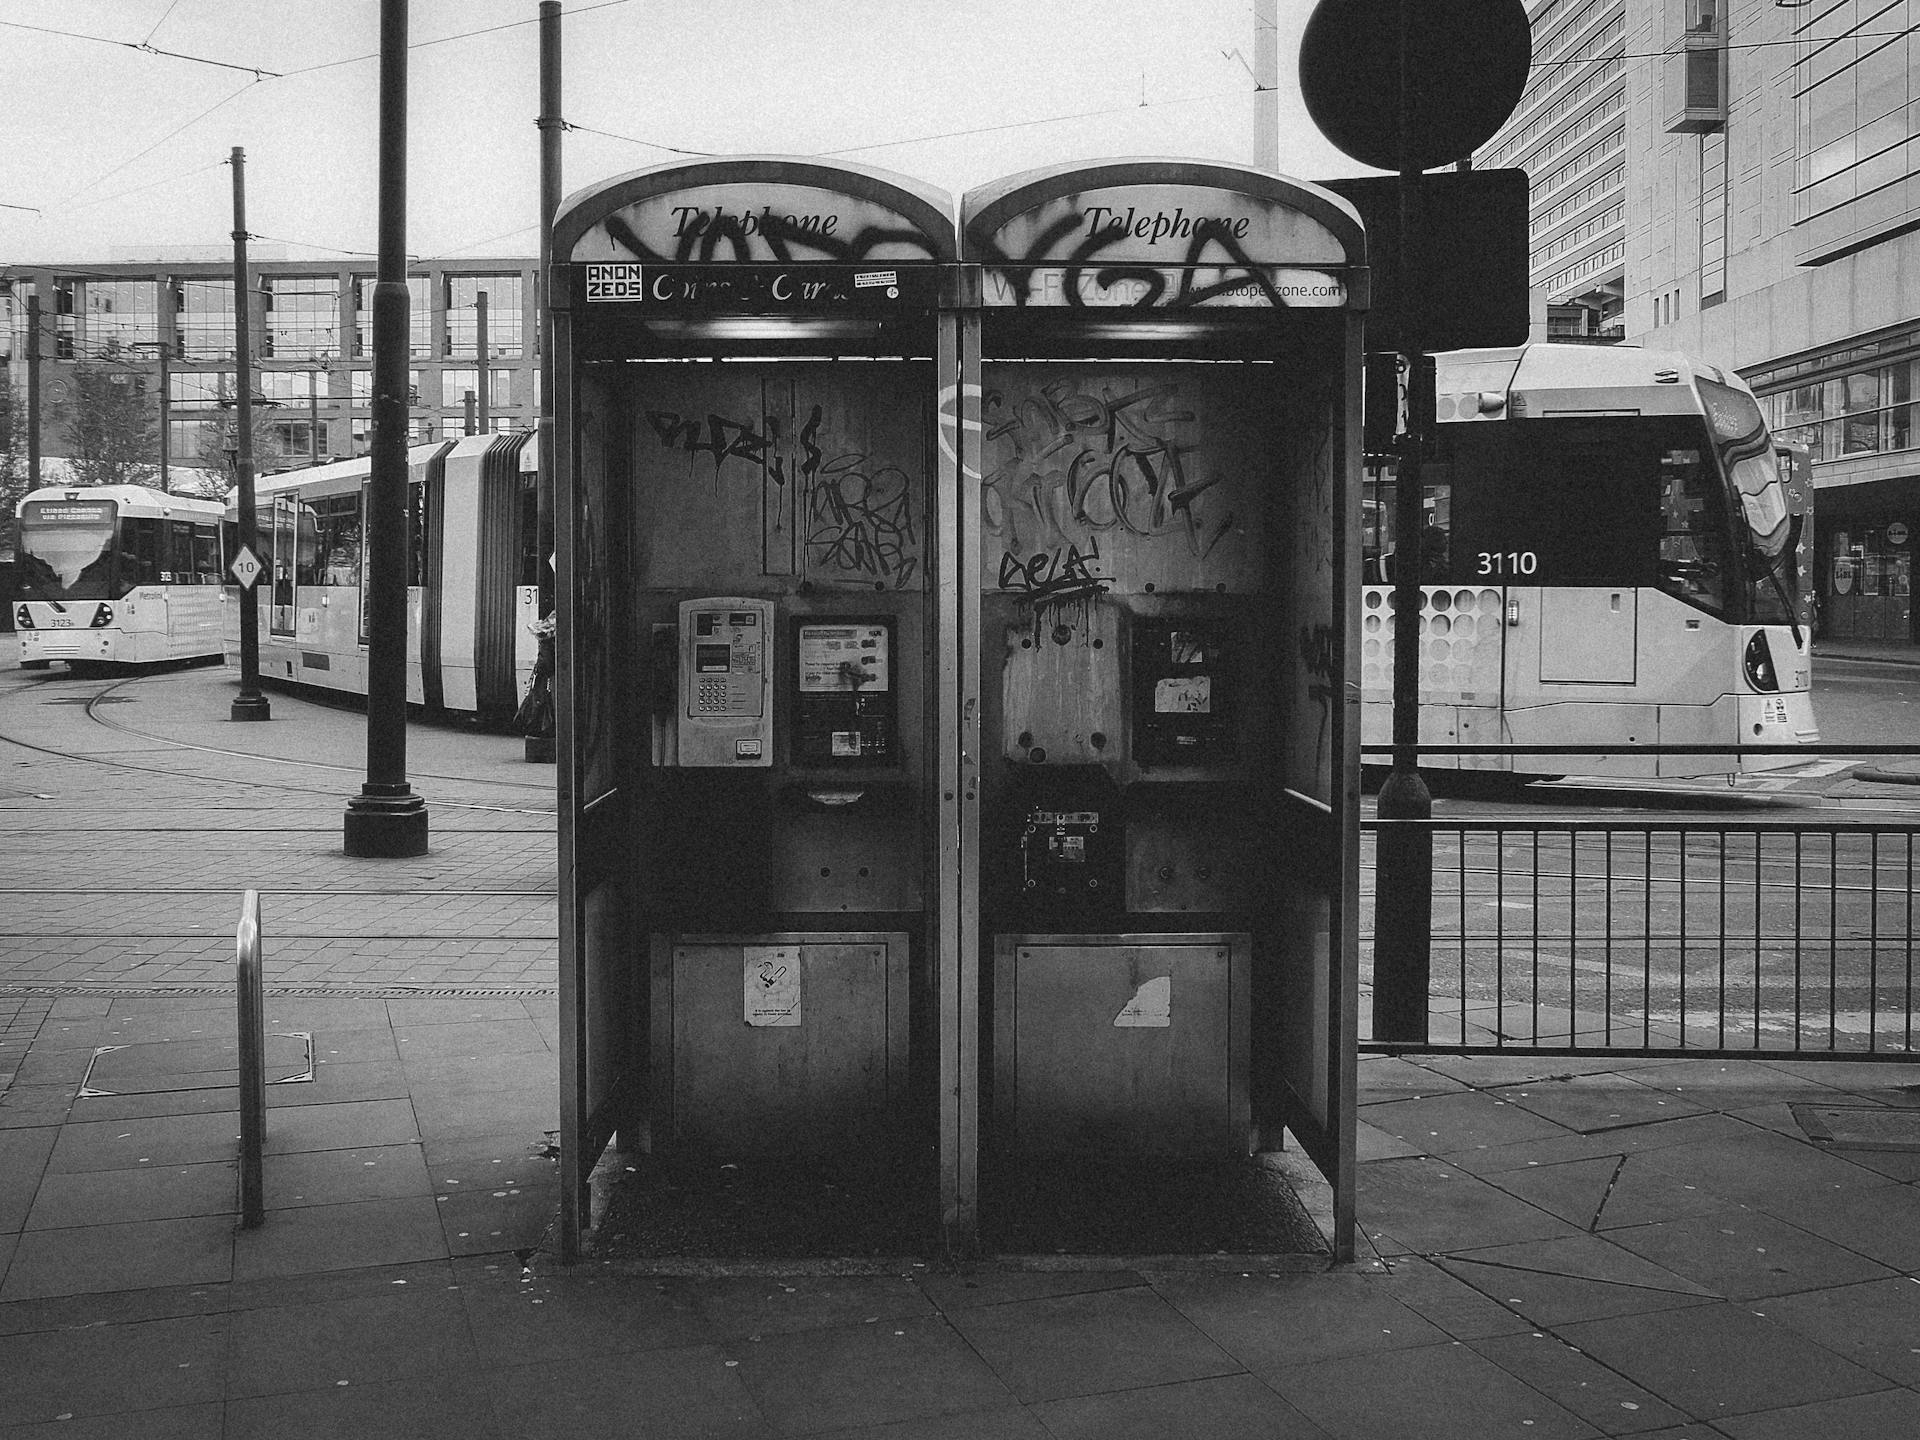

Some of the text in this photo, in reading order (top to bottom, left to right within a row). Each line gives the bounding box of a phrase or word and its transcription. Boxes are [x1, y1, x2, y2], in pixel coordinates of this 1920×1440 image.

[588, 266, 640, 281] ANON
[588, 282, 641, 296] ZEDS
[239, 562, 254, 573] 10
[1478, 552, 1537, 575] 3110
